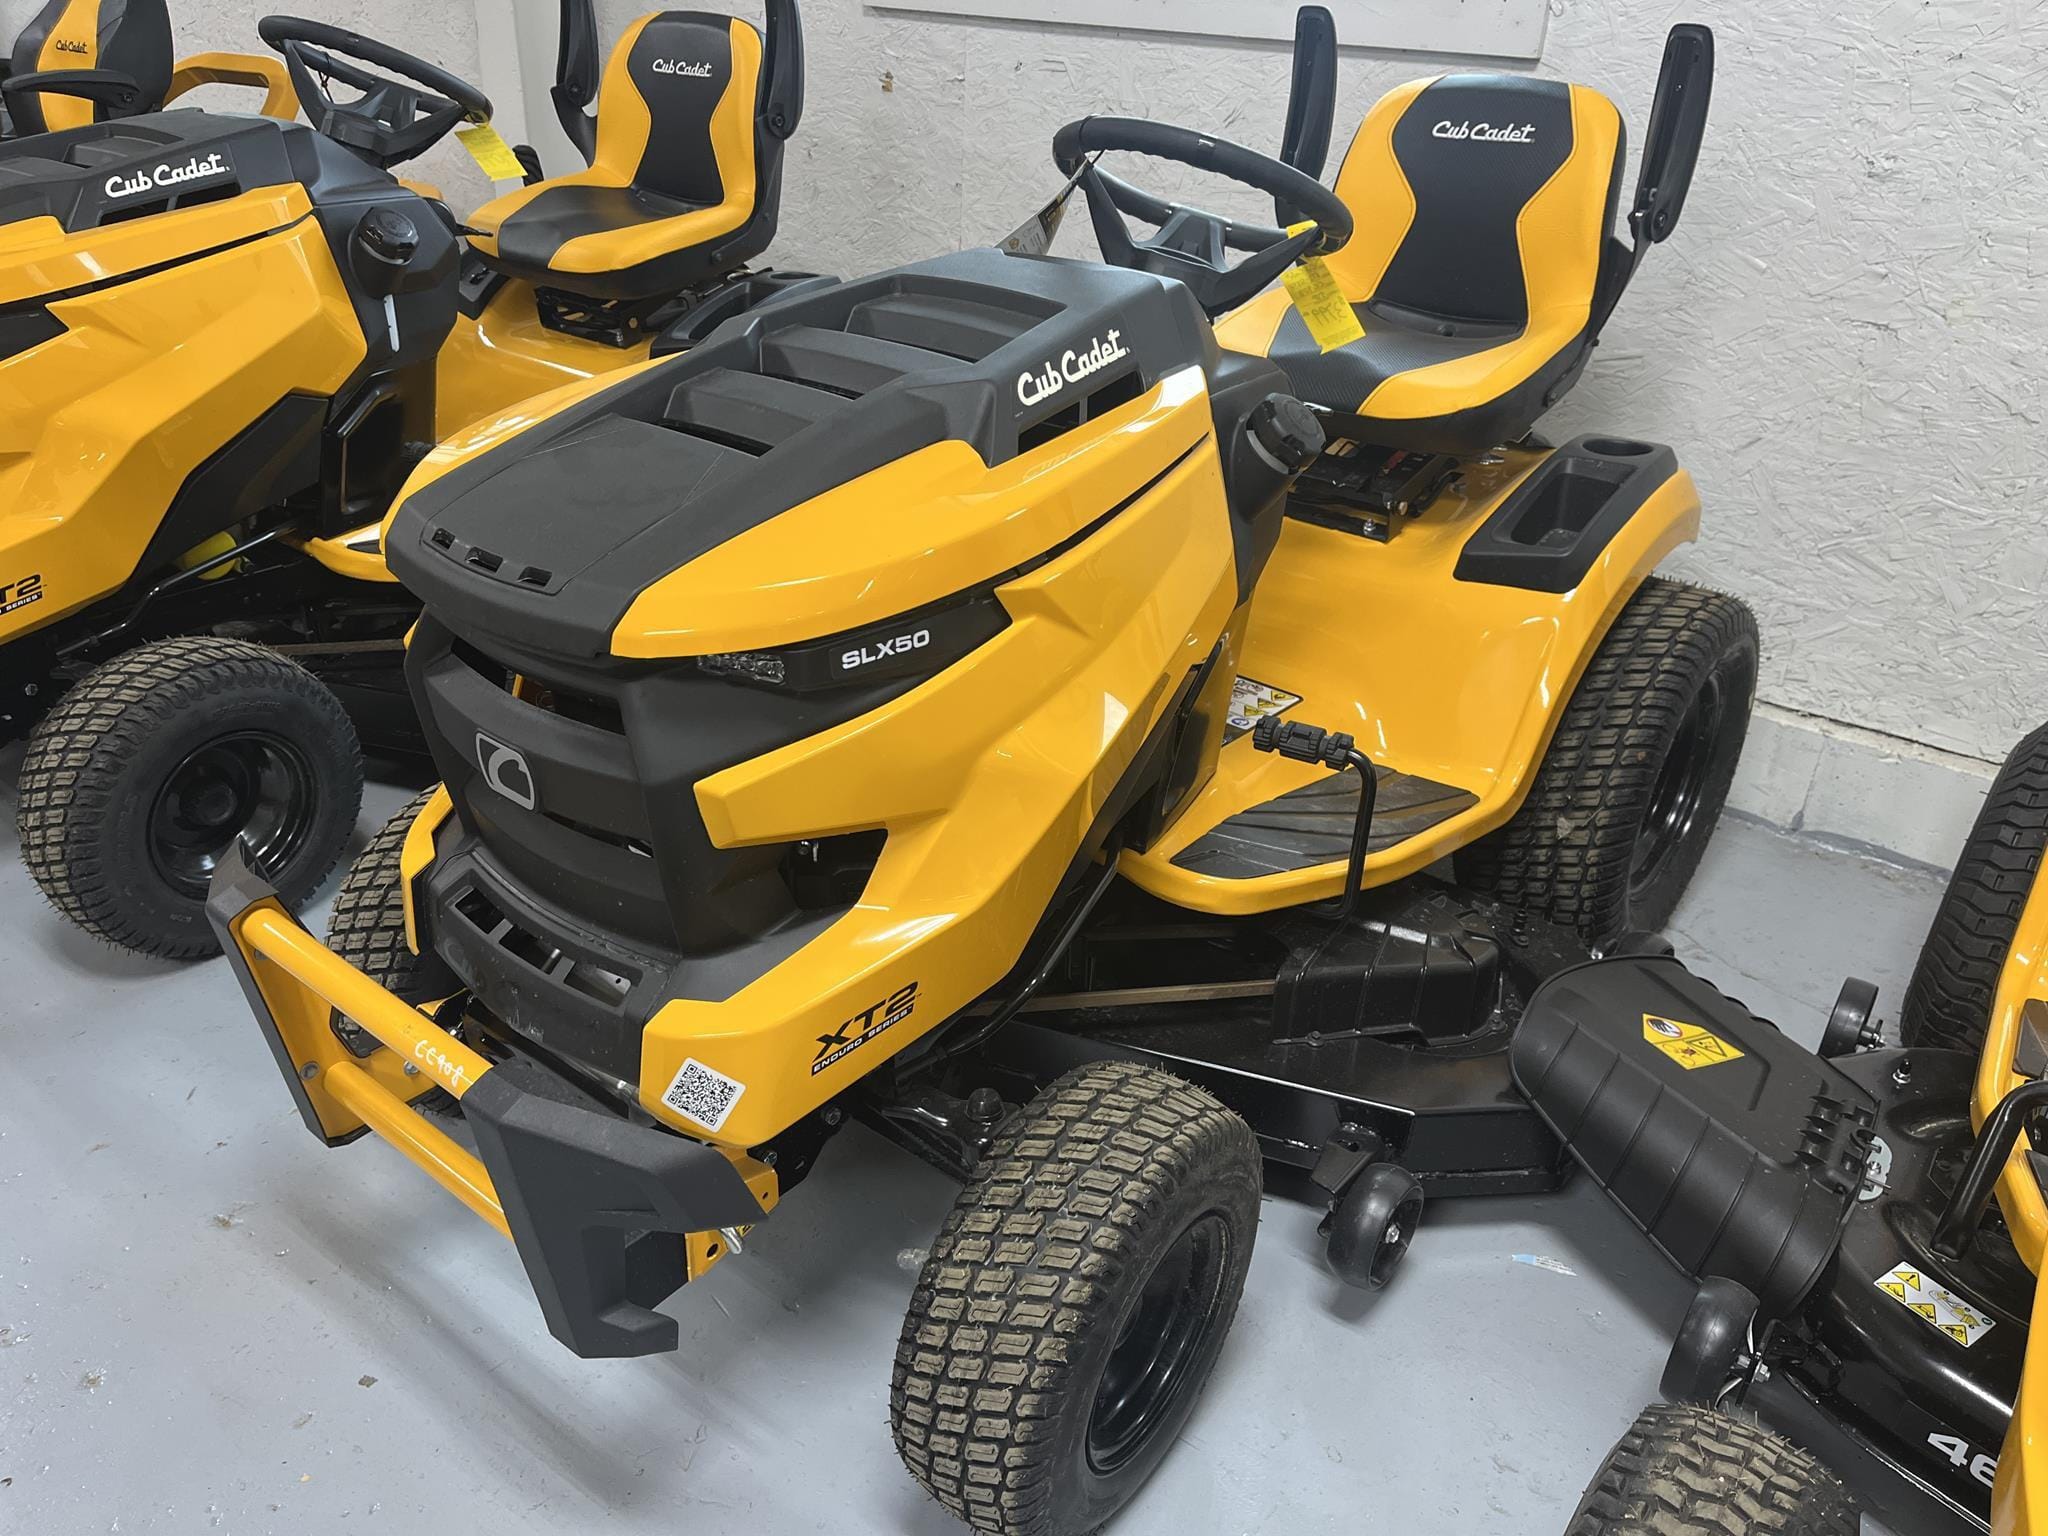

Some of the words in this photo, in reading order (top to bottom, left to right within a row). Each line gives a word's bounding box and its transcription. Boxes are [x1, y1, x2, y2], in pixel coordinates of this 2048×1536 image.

[653, 59, 675, 74] Cub
[676, 61, 712, 77] Cadet
[1432, 120, 1469, 139] Cub
[1470, 123, 1535, 142] Cadet
[105, 170, 152, 198] Cub
[153, 153, 226, 186] Cadet
[1017, 361, 1063, 406] Cub
[1061, 329, 1127, 383] Cadet
[841, 629, 930, 670] SLX50
[812, 981, 918, 1063] XT2
[813, 1038, 863, 1073] ENDURO
[867, 1008, 908, 1038] SERIES
